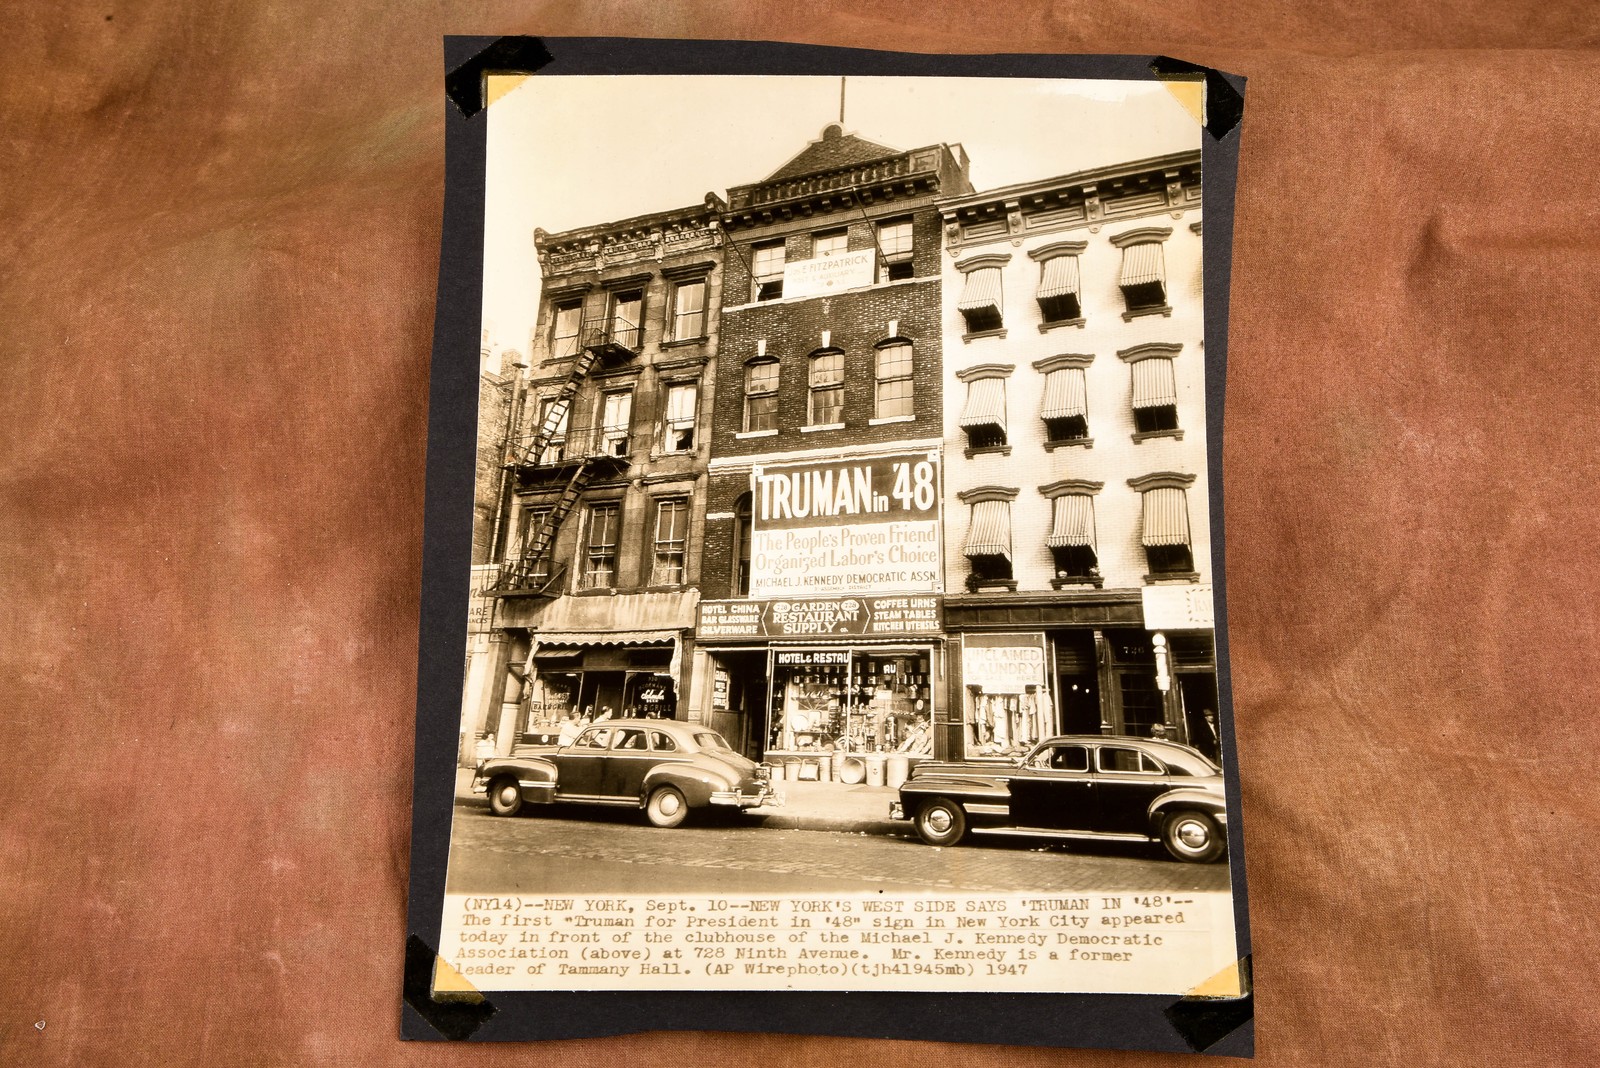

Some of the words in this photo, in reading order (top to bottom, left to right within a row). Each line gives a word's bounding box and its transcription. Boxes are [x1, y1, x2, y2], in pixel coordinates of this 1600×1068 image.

[810, 255, 868, 272] FITZPATRICK
[758, 466, 872, 520] TRUMAN
[872, 491, 889, 513] in
[892, 461, 935, 511] '48
[756, 532, 783, 551] The
[786, 530, 838, 554] People's
[841, 527, 886, 547] Proven
[889, 524, 936, 544] Friend
[755, 552, 826, 574] Organized
[830, 549, 885, 567] Labor's
[888, 544, 937, 564] Choice
[756, 576, 794, 588] MICHAEL
[804, 574, 844, 586] KENNEDY
[846, 572, 906, 584] DEMOCRATIC
[702, 604, 728, 614] HOTEL
[730, 604, 760, 614] CHINA
[791, 602, 840, 612] GARDEN
[874, 598, 908, 610] COFFEE
[910, 598, 937, 608] URNS
[701, 615, 718, 624] BAR
[718, 614, 760, 624] GLASSWARE
[772, 610, 860, 624] RESTAURANT
[874, 610, 902, 620] STEAM
[902, 609, 936, 620] TABLES
[700, 625, 758, 634] SILVERWARE
[783, 622, 838, 634] SUPPLY
[873, 621, 904, 632] KITCHEN
[904, 620, 940, 630] UTENSILS
[778, 653, 806, 664] HOTEL
[813, 652, 849, 664] RESTAU
[964, 648, 1040, 661] UNCLAIMED
[966, 662, 1041, 675] LAUNDRY
[585, 900, 634, 914] YORK,
[646, 900, 696, 914] Sept.
[791, 900, 852, 912] YORK'S
[863, 900, 904, 912] WEST
[914, 900, 956, 912] SIDE
[966, 900, 1006, 912] SAYS
[1022, 898, 1090, 912] 'TRUMAN
[1102, 898, 1122, 910] IN
[462, 914, 492, 926] The
[500, 914, 552, 926] first
[564, 915, 634, 928] "Truman
[644, 916, 676, 928] for
[686, 916, 779, 928] President
[790, 916, 811, 928] in
[872, 916, 914, 930] sign
[926, 916, 945, 928] in
[956, 916, 987, 928] New
[998, 915, 1040, 928] York
[1050, 914, 1090, 928] City
[1102, 912, 1185, 928] appeared
[459, 930, 508, 945] today
[520, 931, 540, 943] in
[548, 931, 600, 944] front
[612, 931, 632, 944] of
[644, 931, 673, 944] the
[685, 931, 776, 944] clubhouse
[788, 931, 808, 944] of
[820, 932, 850, 944] the
[861, 932, 932, 944] Michael
[944, 932, 963, 944] J.
[975, 932, 1048, 947] Kennedy
[1058, 932, 1164, 946] Democratic
[456, 947, 569, 959] Association
[581, 947, 651, 960] (above)
[662, 948, 683, 959] at
[694, 947, 726, 958] 728
[735, 947, 787, 960] Ninth
[798, 948, 869, 960] Avenue.
[892, 948, 921, 960] Mr.
[934, 948, 1006, 962] Kennedy
[1018, 948, 1038, 960] is
[1049, 950, 1059, 960] a
[1069, 949, 1133, 962] former
[455, 963, 515, 975] leader
[527, 963, 546, 975] of
[558, 963, 630, 978] Tammany
[639, 963, 692, 975] Hall.
[705, 962, 734, 976] (AP
[986, 963, 1028, 976] 1947
